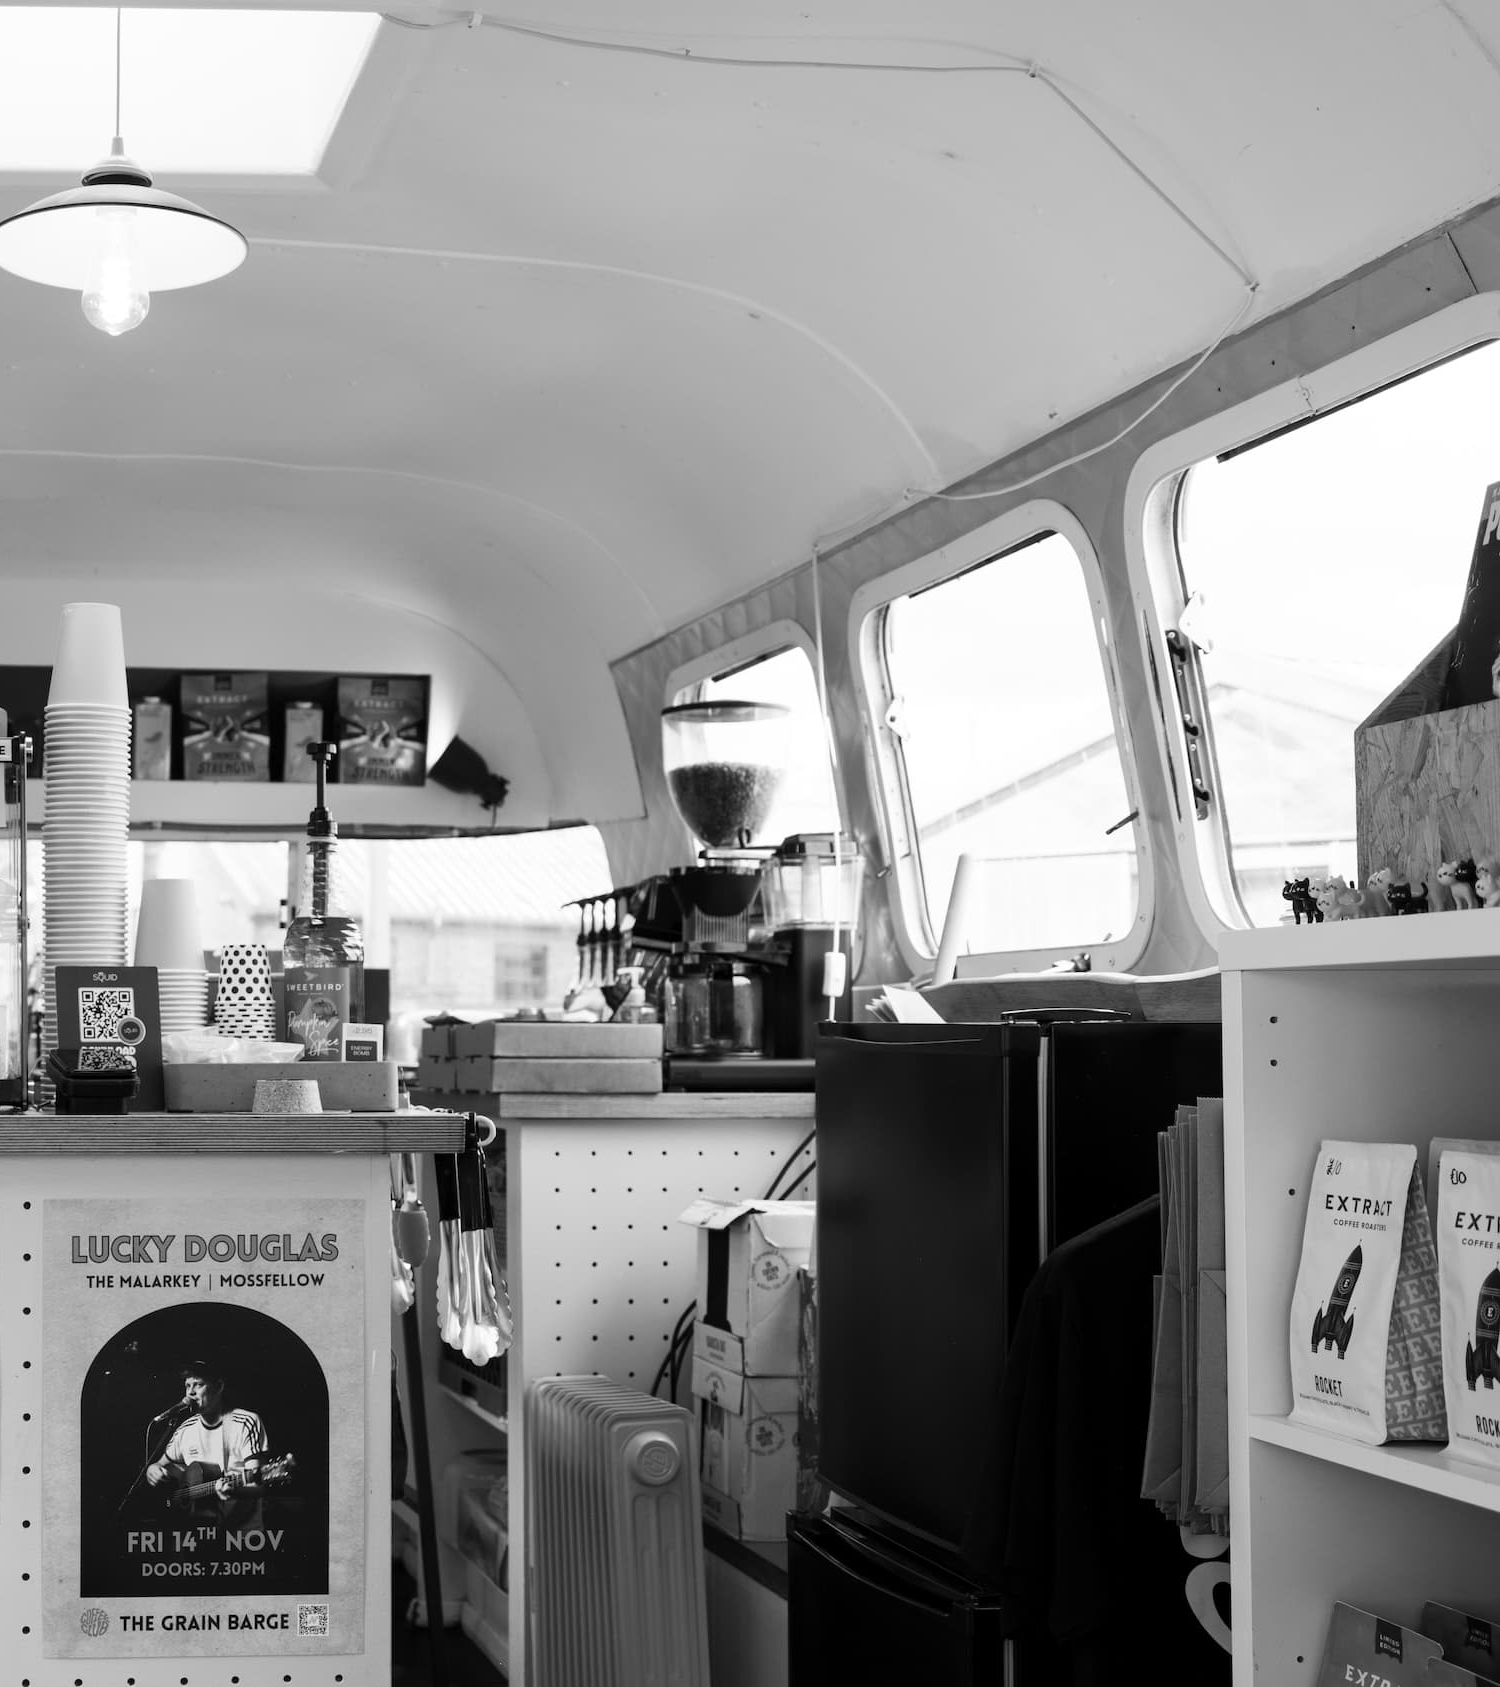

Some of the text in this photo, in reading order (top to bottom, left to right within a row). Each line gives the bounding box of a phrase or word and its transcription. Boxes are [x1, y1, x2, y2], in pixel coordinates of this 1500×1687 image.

[93, 972, 117, 983] SQUID
[1325, 1194, 1392, 1216] EXTRACT
[1334, 1219, 1387, 1231] COFFEE ROASTERS
[71, 1233, 339, 1263] LUCKY DOUGLAS
[87, 1273, 324, 1288] THE MALARKEY MOSSFELLOW
[1315, 1375, 1342, 1397] ROCKET
[128, 1531, 162, 1552] FRI
[142, 1562, 265, 1576] DOORS: 7.30PM
[120, 1614, 289, 1632] THE GRAIN BARGE
